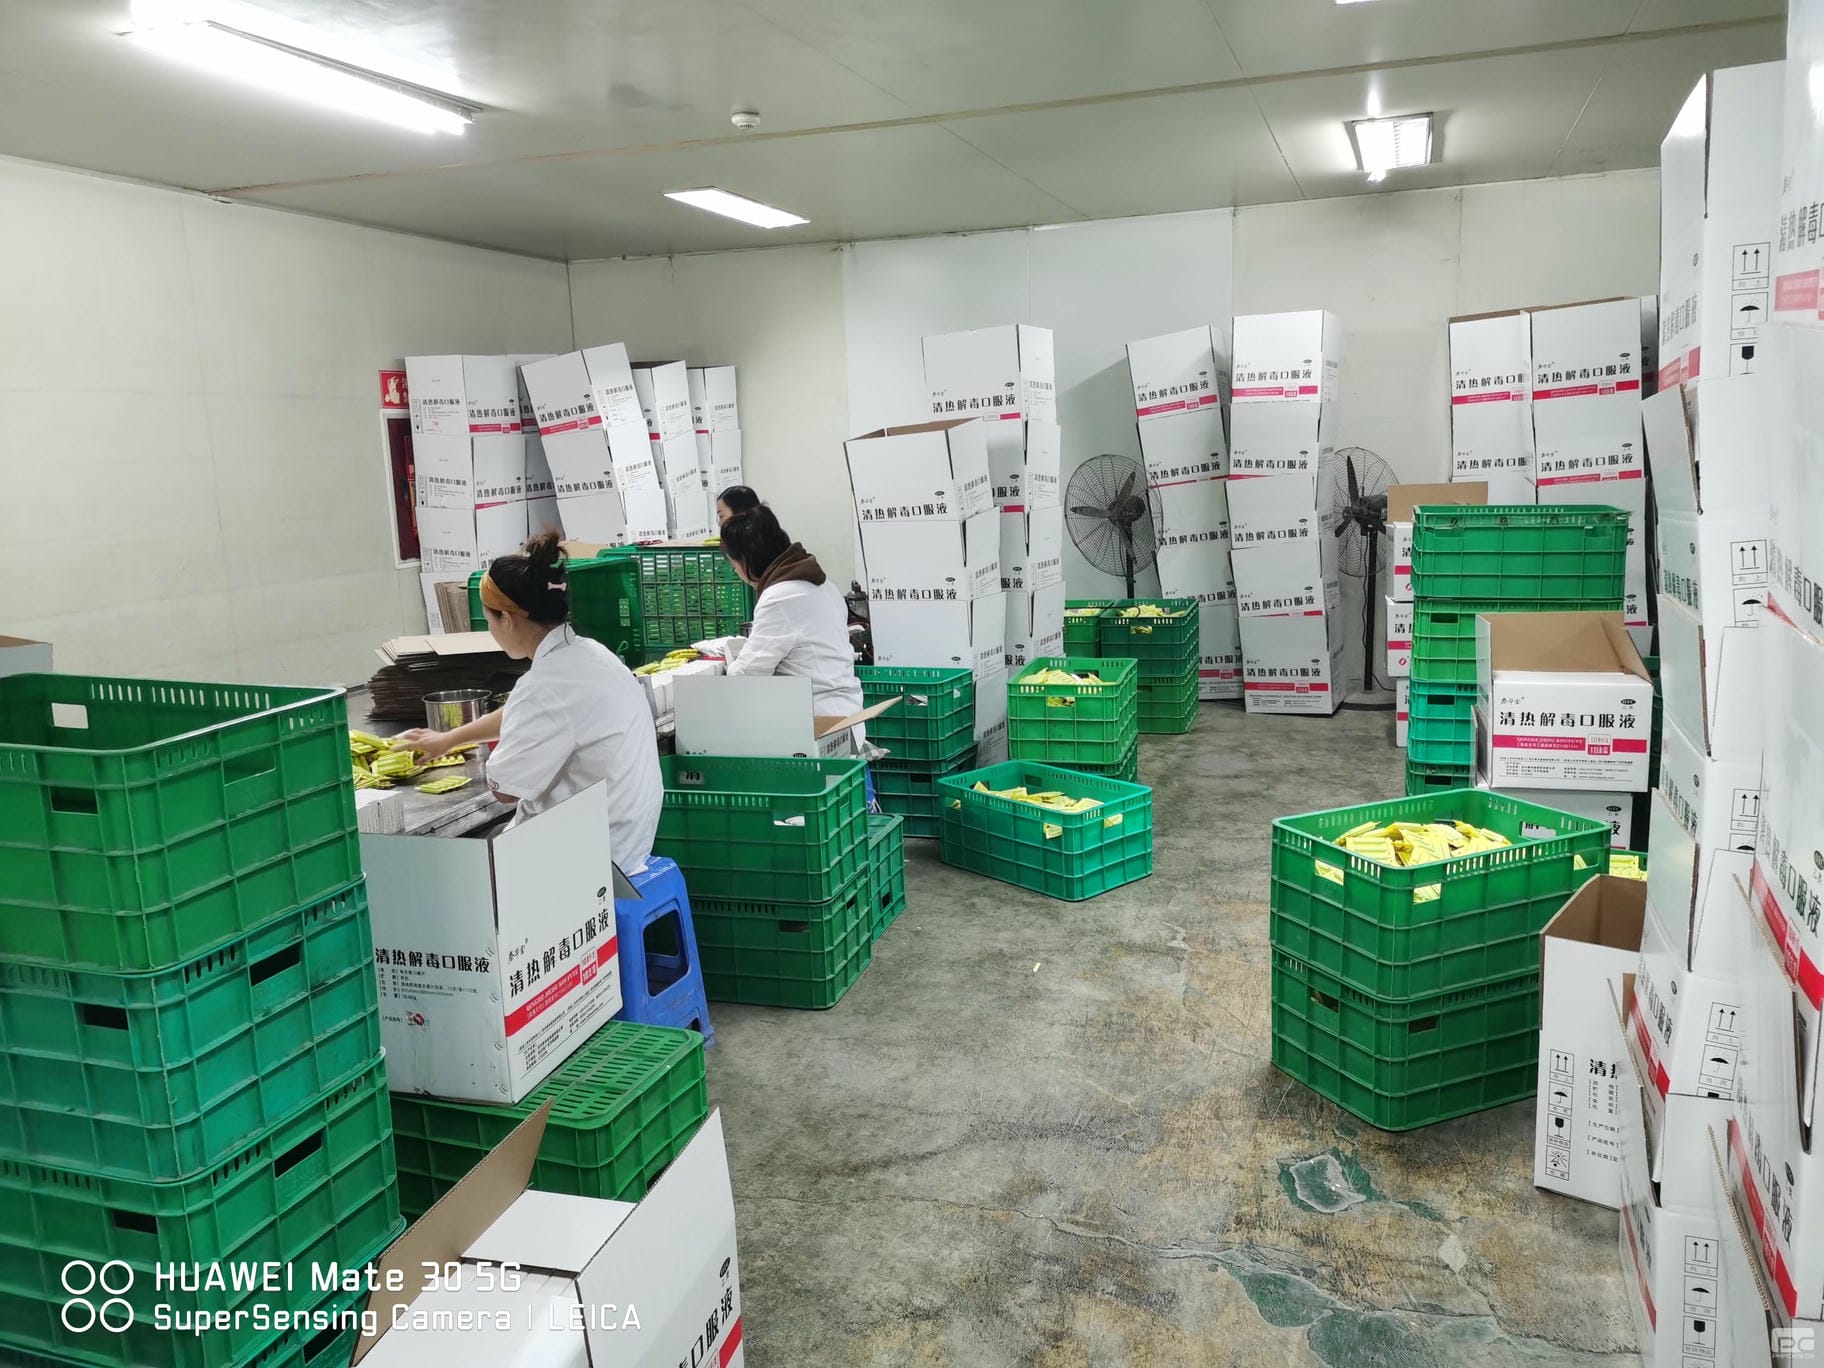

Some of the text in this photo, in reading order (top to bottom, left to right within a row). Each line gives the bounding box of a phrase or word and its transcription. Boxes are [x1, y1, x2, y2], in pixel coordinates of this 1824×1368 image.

[1235, 368, 1312, 383] 清热解毒口服液
[1537, 363, 1631, 384] 清热解毒口服液
[1138, 380, 1209, 402] 清热解毒口服液
[933, 393, 1016, 414] 清热解毒口服液
[539, 405, 594, 423] 清热解毒口服液
[1149, 461, 1221, 481] 清热解毒口服液
[1233, 458, 1308, 470] 清热解毒口服液
[1541, 453, 1633, 472] 清热解毒口服液
[557, 479, 613, 493] 清热解毒口服液
[992, 485, 1020, 498] 服液
[862, 502, 948, 521] 清热解毒口服液
[1234, 528, 1308, 543] 清热解毒口服液
[872, 588, 957, 600] 清热解毒口服液
[1240, 595, 1315, 612] 清热解毒口服液
[1246, 667, 1321, 677] 清热解毒口服液
[1500, 711, 1636, 729] 清热解毒口服液
[375, 948, 490, 973] 清热解毒口服液
[510, 908, 609, 998] 清热解毒口服液
[679, 1286, 733, 1368] 口服液
